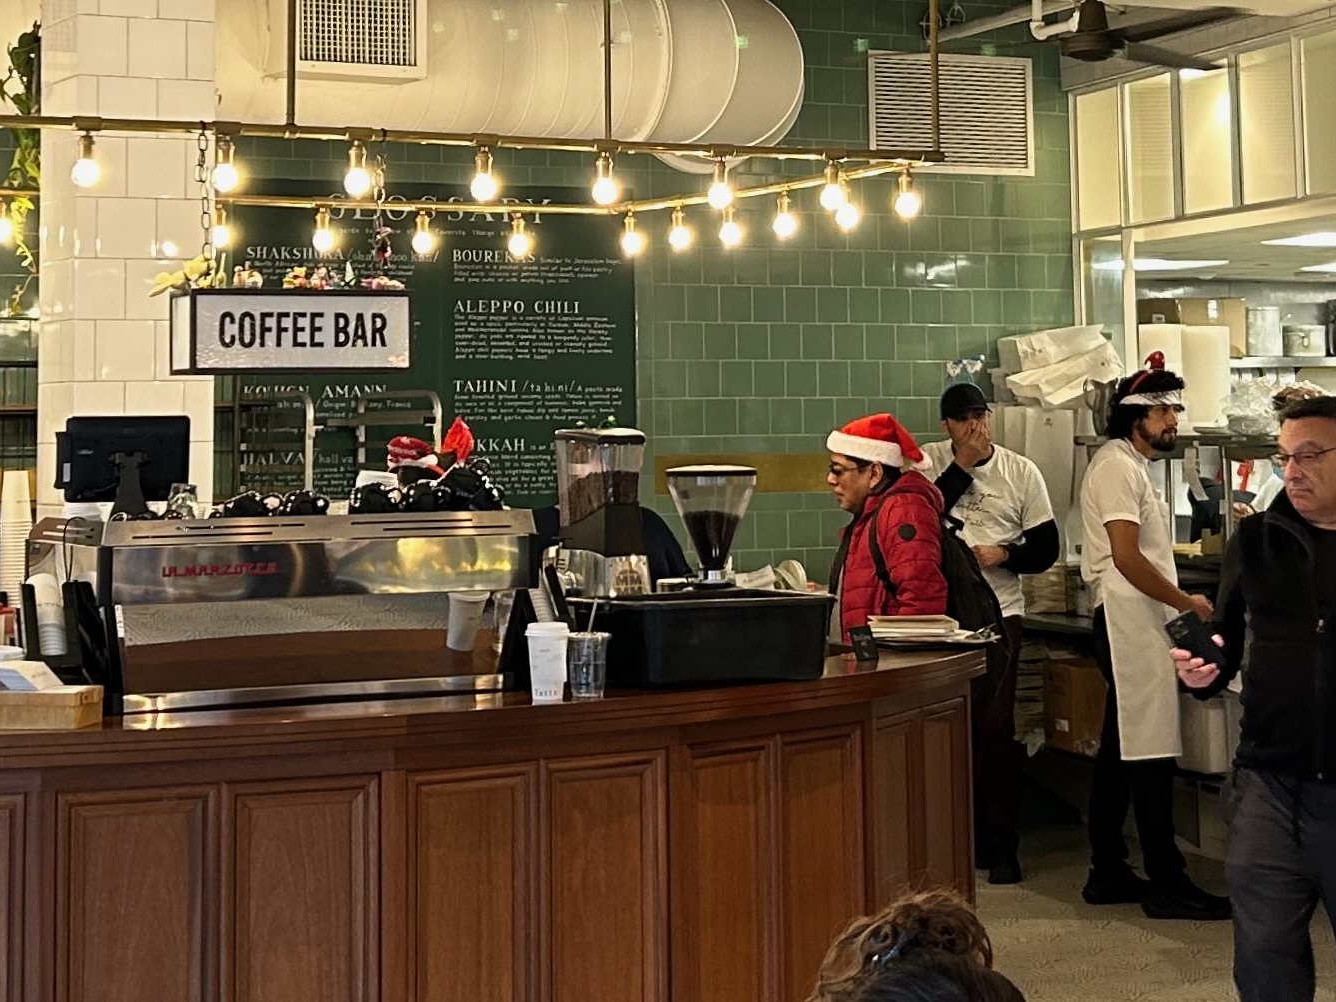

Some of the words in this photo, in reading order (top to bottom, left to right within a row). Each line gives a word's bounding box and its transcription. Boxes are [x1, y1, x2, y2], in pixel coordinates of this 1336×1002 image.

[454, 300, 525, 314] ALEPPO
[534, 301, 580, 314] CHILI
[219, 311, 324, 349] COFFEE
[334, 312, 387, 348] BAR
[453, 380, 516, 393] TAHINI
[476, 438, 525, 452] KKAH
